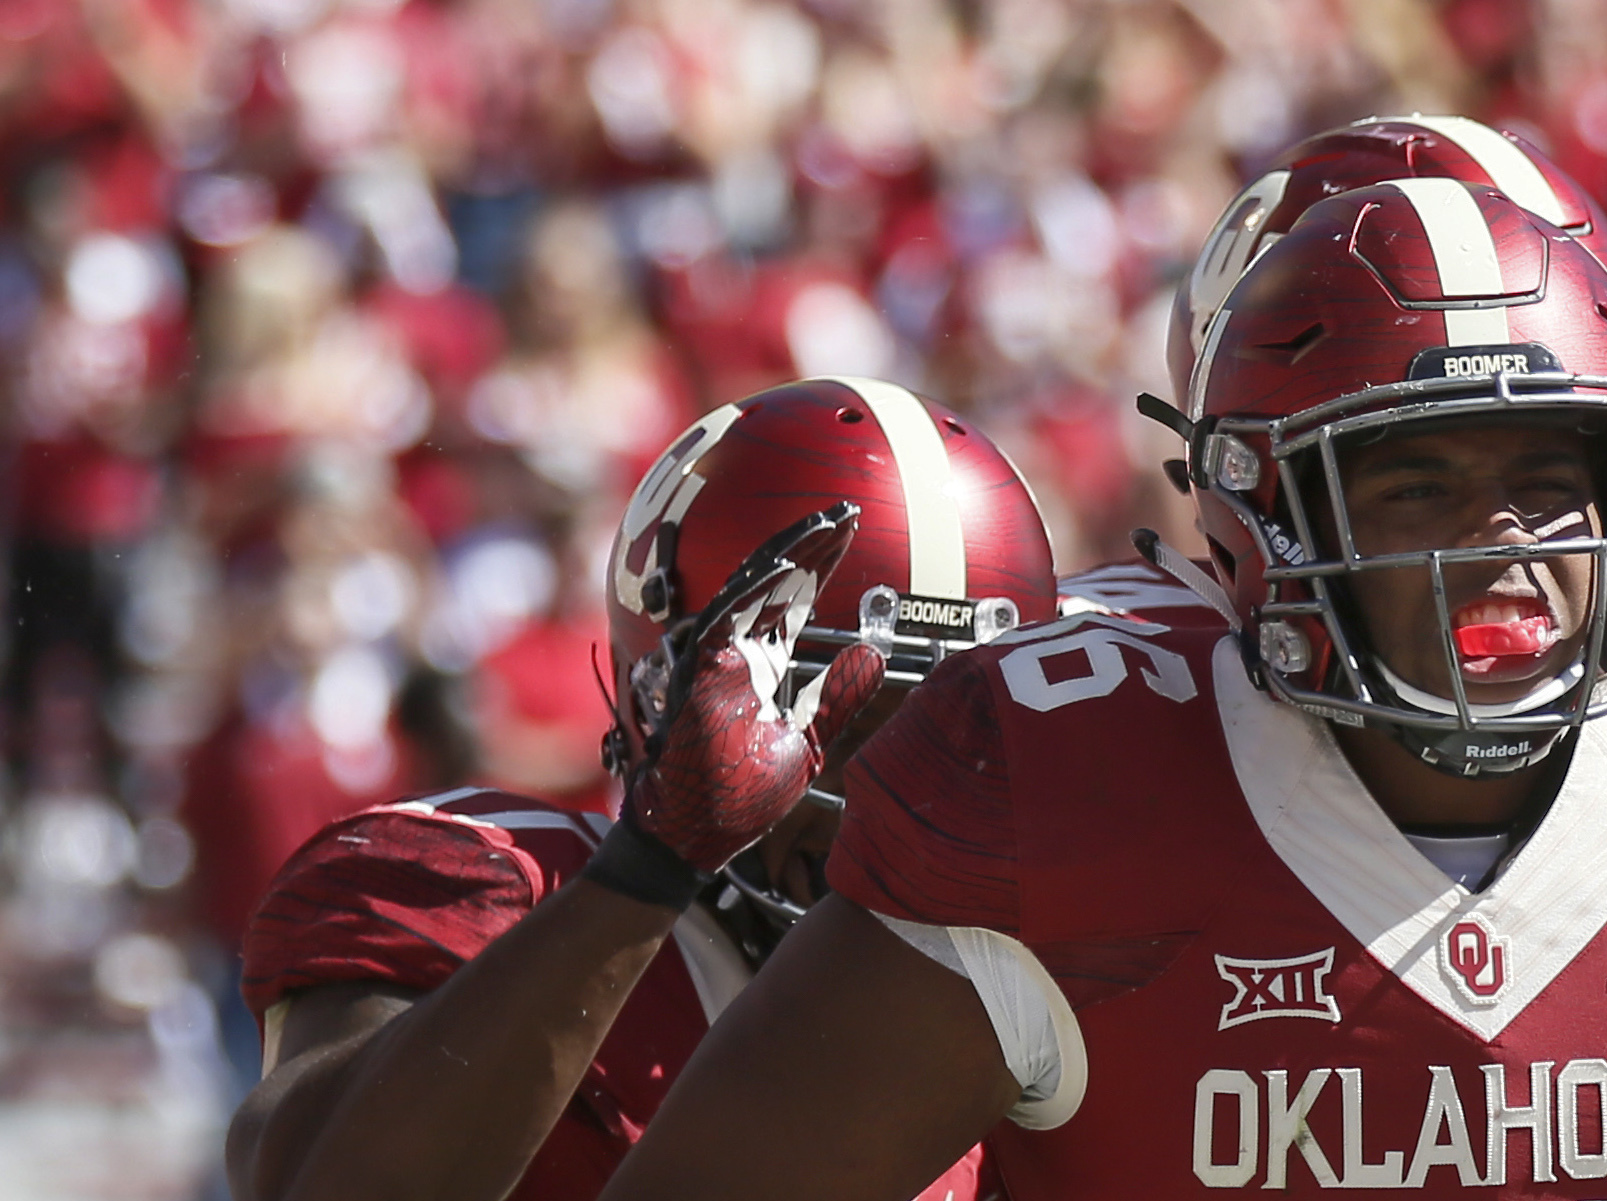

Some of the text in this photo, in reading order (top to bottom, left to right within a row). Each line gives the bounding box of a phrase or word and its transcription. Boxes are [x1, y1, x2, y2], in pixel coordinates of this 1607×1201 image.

[1443, 354, 1529, 378] BOOMER
[899, 600, 973, 627] BOOMER
[1465, 741, 1531, 758] Riddell
[1448, 921, 1505, 996] OU
[1218, 956, 1336, 1026] XII
